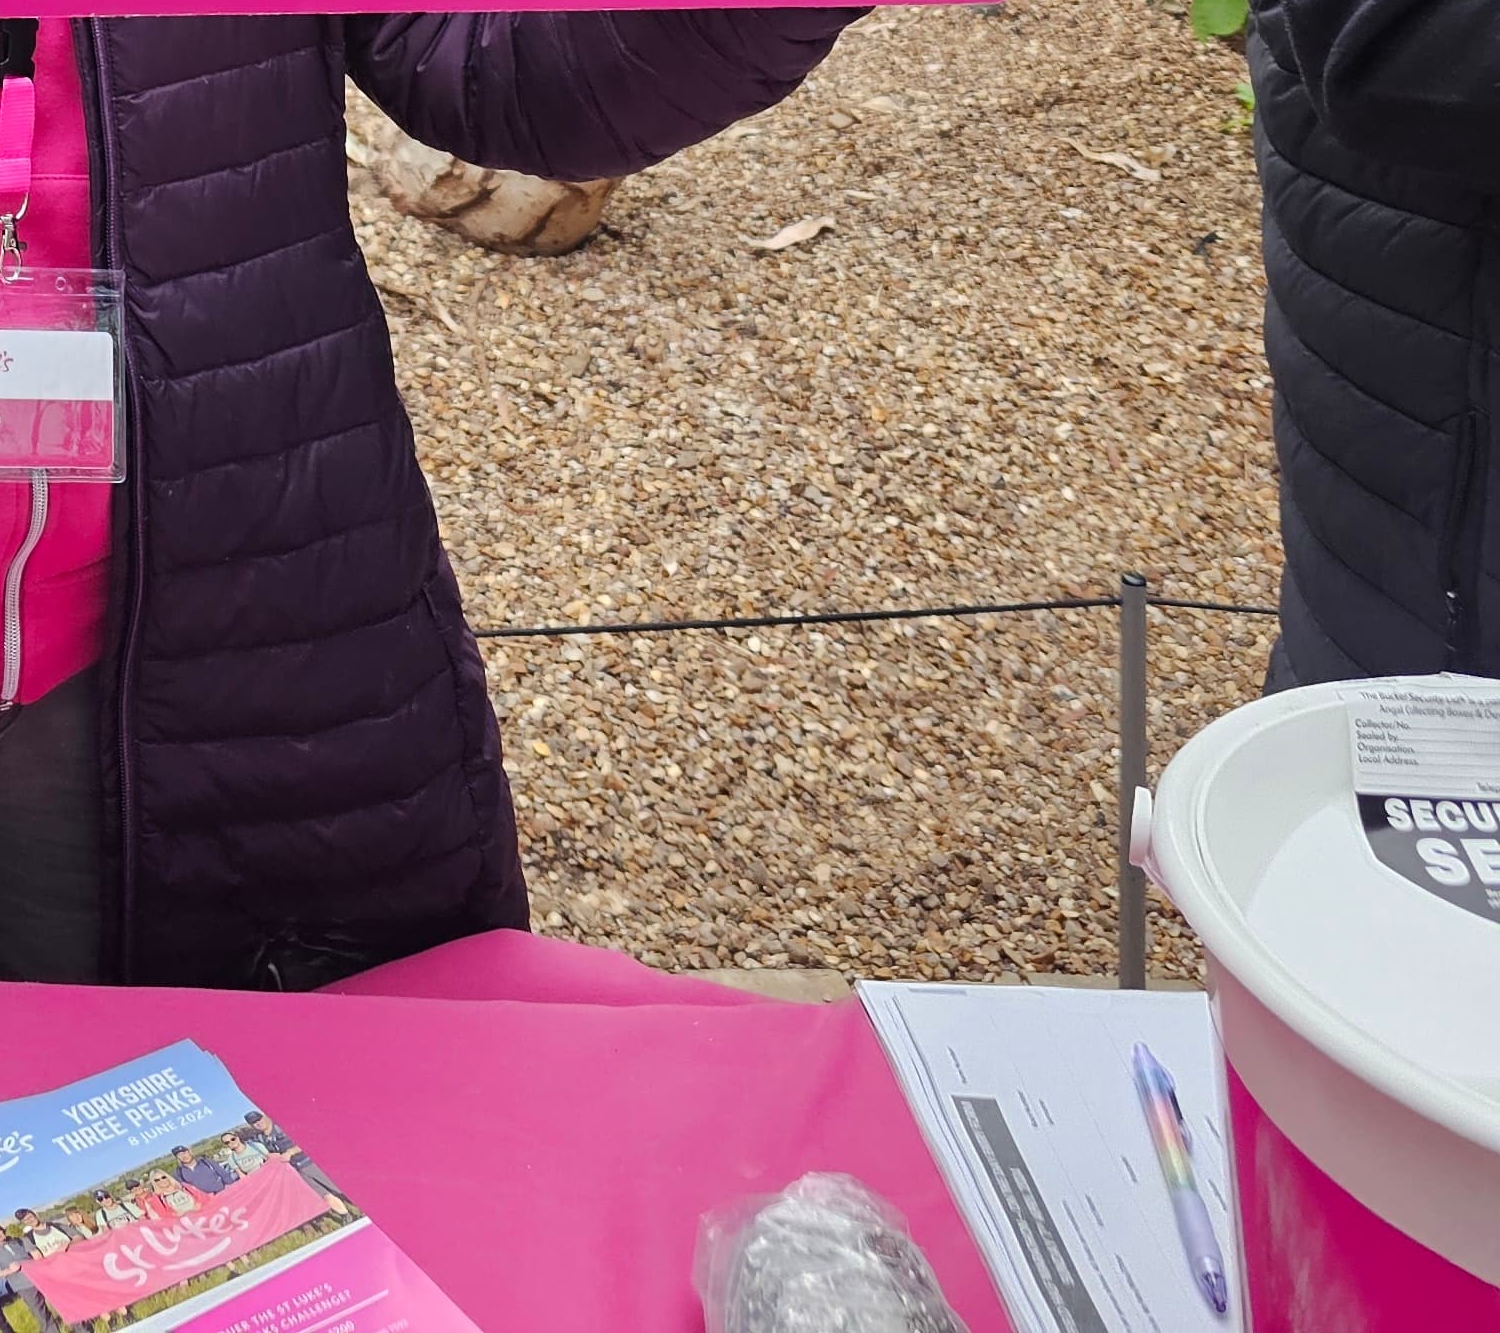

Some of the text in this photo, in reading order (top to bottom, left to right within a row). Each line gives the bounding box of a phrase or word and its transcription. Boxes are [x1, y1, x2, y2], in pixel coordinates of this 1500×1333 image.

[1356, 730, 1386, 741] Sealed
[1358, 754, 1381, 764] Local
[61, 1067, 185, 1126] YORKSHIRE
[51, 1085, 203, 1156] THREE PEAKS
[128, 1104, 213, 1147] 8 JUNE 2024
[251, 1282, 333, 1326] THE ST LUKE'S
[280, 1289, 352, 1332] CHALLENGE?
